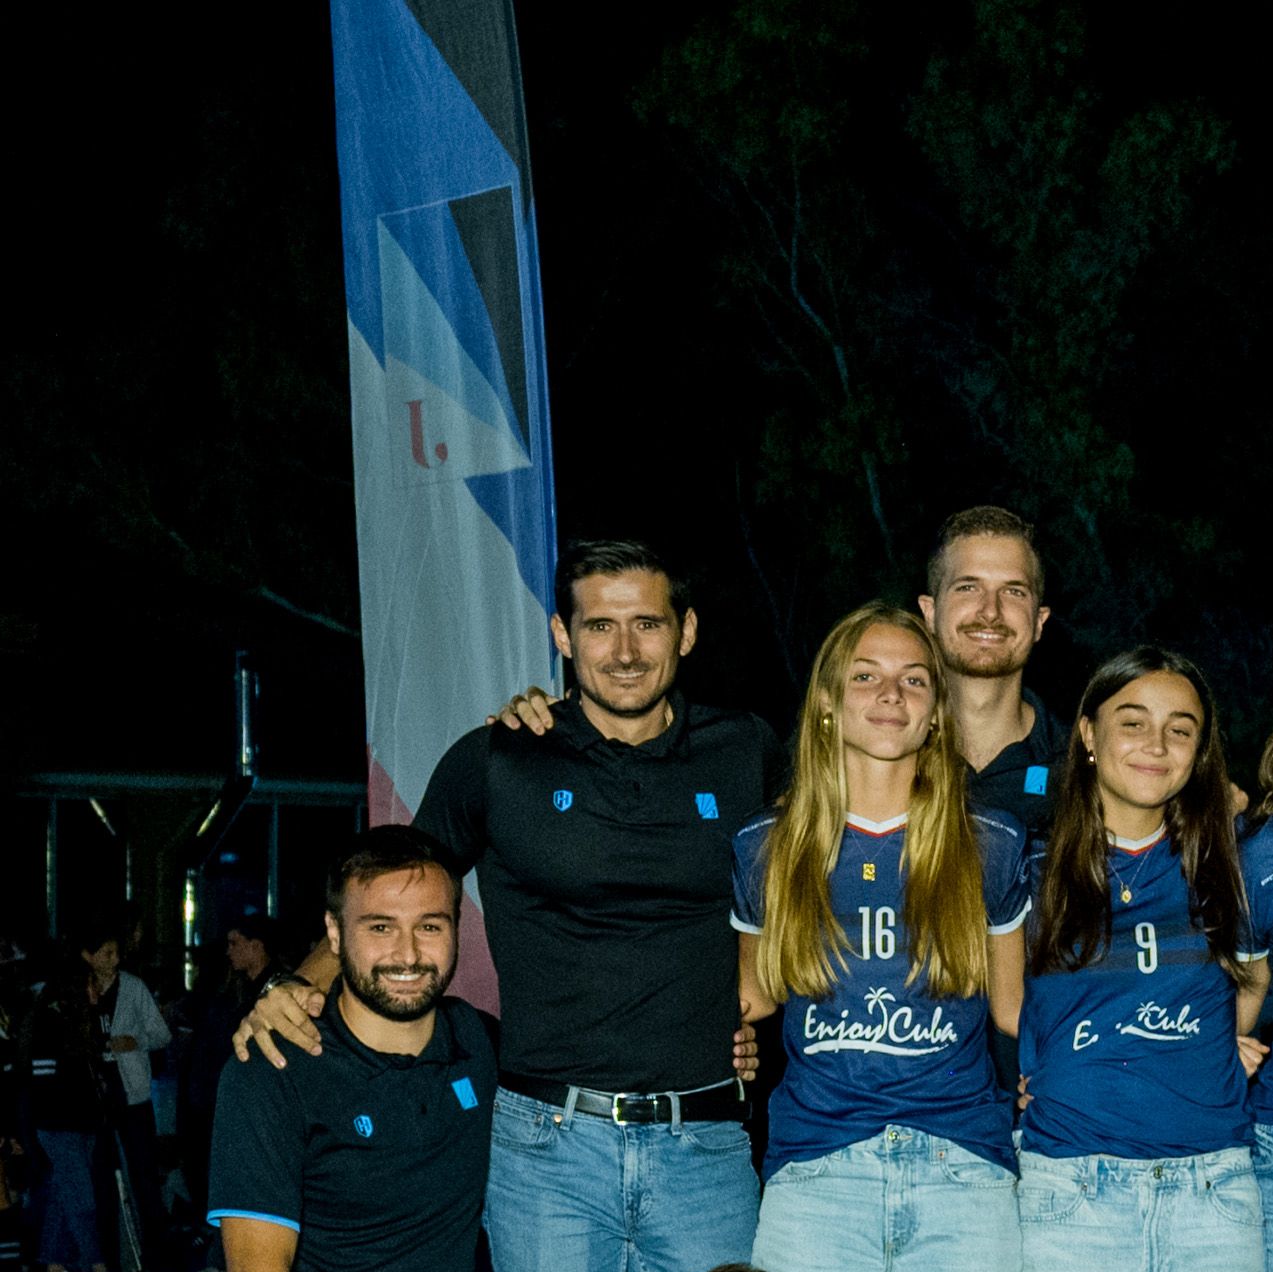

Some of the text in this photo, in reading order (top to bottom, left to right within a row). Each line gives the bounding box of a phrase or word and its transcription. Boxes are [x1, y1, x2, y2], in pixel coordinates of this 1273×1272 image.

[858, 906, 896, 960] 16
[1134, 921, 1159, 975] 9
[804, 1003, 958, 1048] Enjoy Cuba
[1143, 1004, 1201, 1035] Cuba
